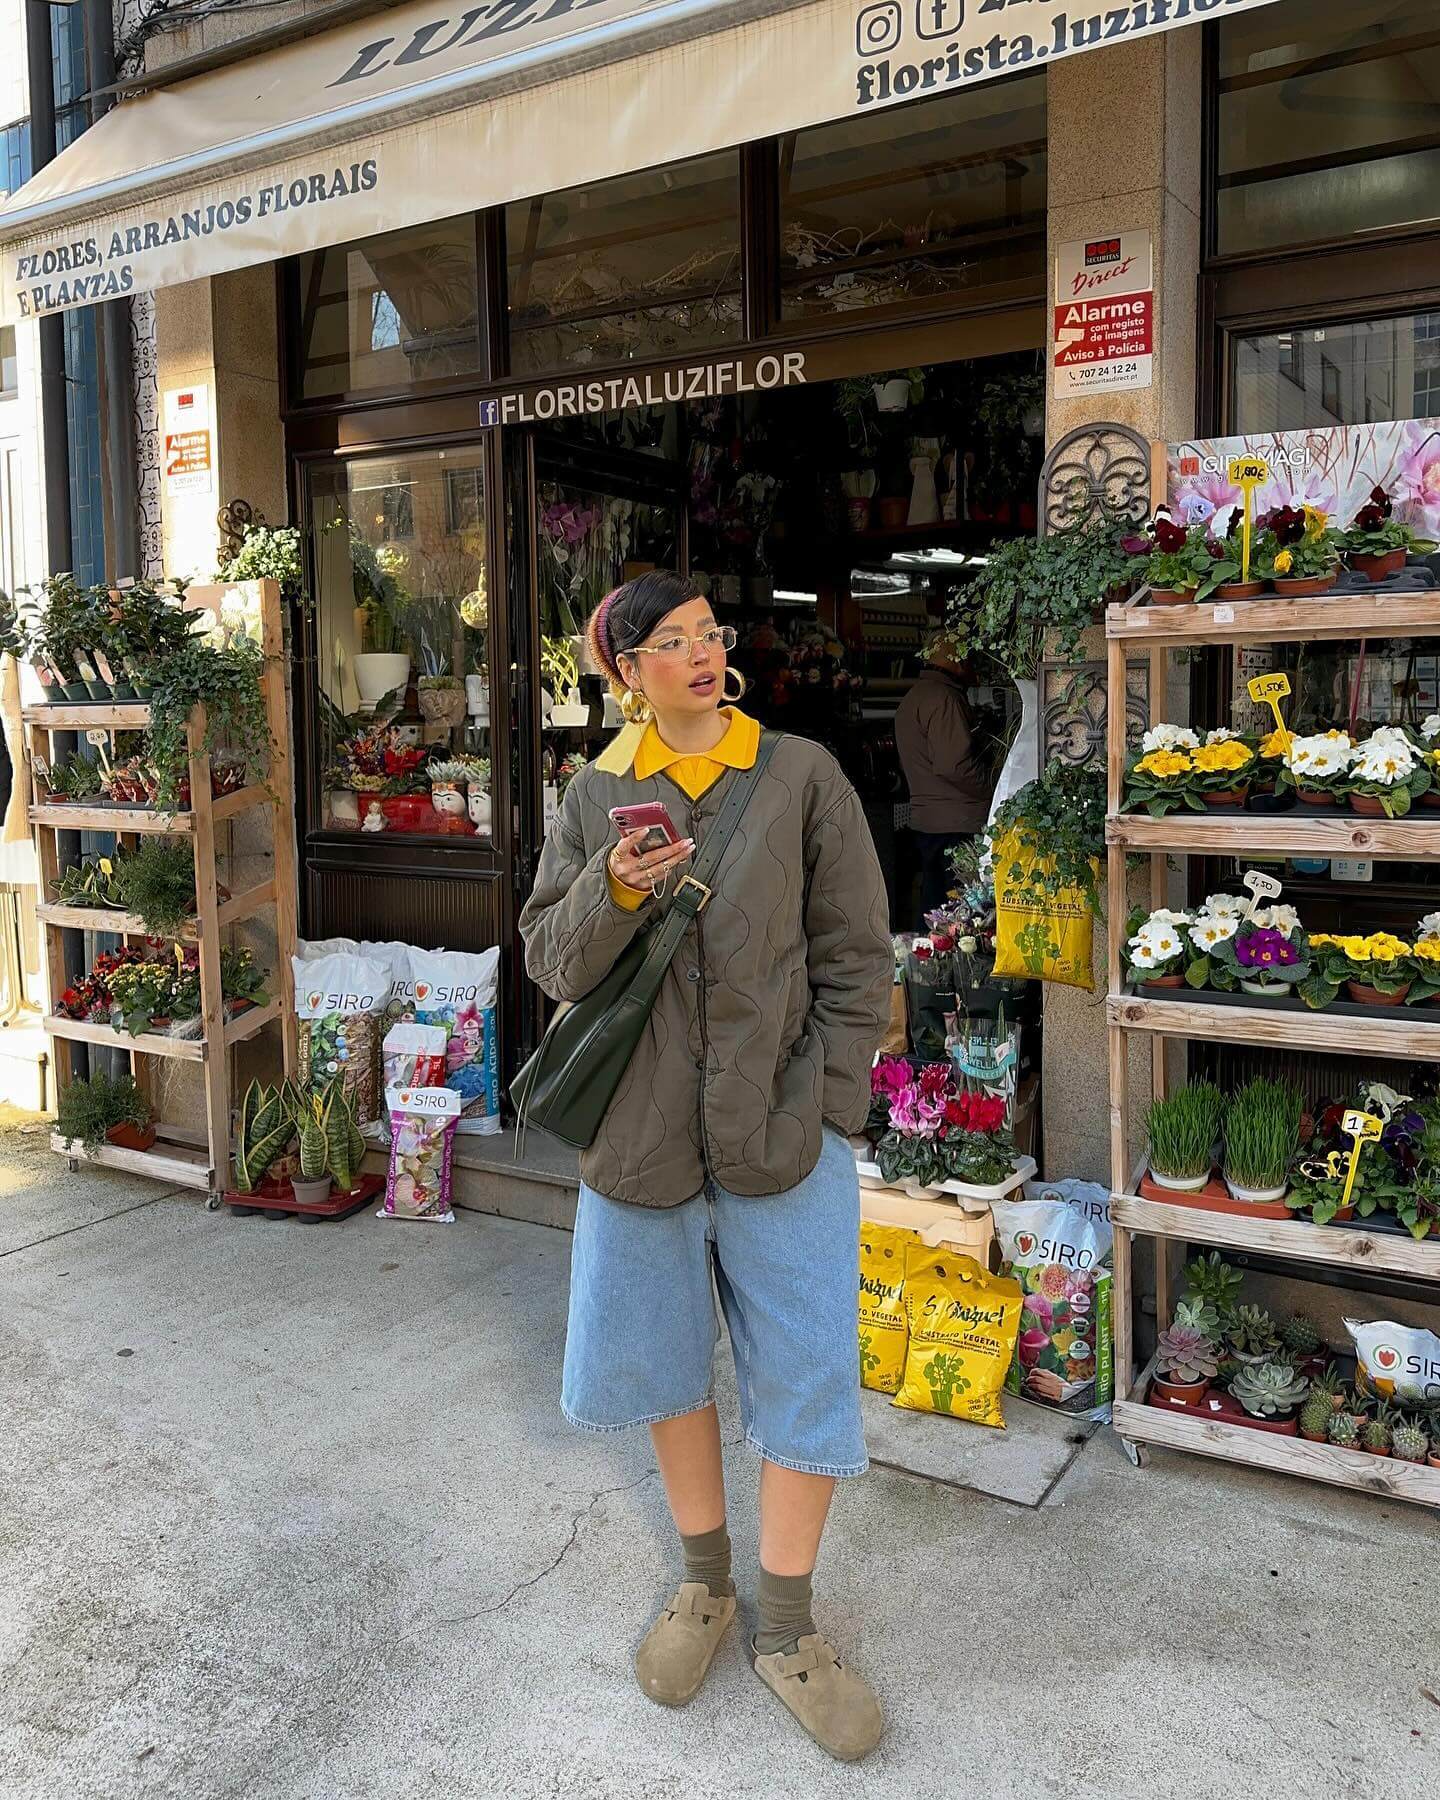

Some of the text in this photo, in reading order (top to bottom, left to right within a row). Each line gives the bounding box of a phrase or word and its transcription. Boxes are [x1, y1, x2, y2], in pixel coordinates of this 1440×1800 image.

[325, 0, 598, 87] LUZ
[857, 0, 1243, 104] florista.luzifl
[15, 160, 378, 281] FLORES, ARRANJOS FLORAIS
[1086, 252, 1120, 263] SECURITAS
[1071, 256, 1138, 296] Direct
[17, 265, 134, 317] E PLANTAS
[1063, 300, 1145, 325] Alarme
[1090, 318, 1145, 333] com registo
[1090, 327, 1145, 342] de imagens
[1063, 341, 1145, 362] Aviso à Polícia
[1079, 362, 1137, 379] 707 24 12 24
[1255, 680, 1285, 697] 1,50€
[1250, 876, 1273, 891] 1,50
[390, 980, 414, 997] IRO
[435, 985, 477, 1002] SIRO
[325, 993, 374, 1010] SIRO
[414, 1093, 447, 1108] SIRO
[1038, 1239, 1093, 1269] SIRO
[871, 1311, 903, 1323] VEGETAL
[946, 1300, 1005, 1332] Miguel
[963, 1332, 1001, 1348] VEGETAL
[1101, 1326, 1110, 1370] PLANT
[1101, 1373, 1109, 1401] SIRO
